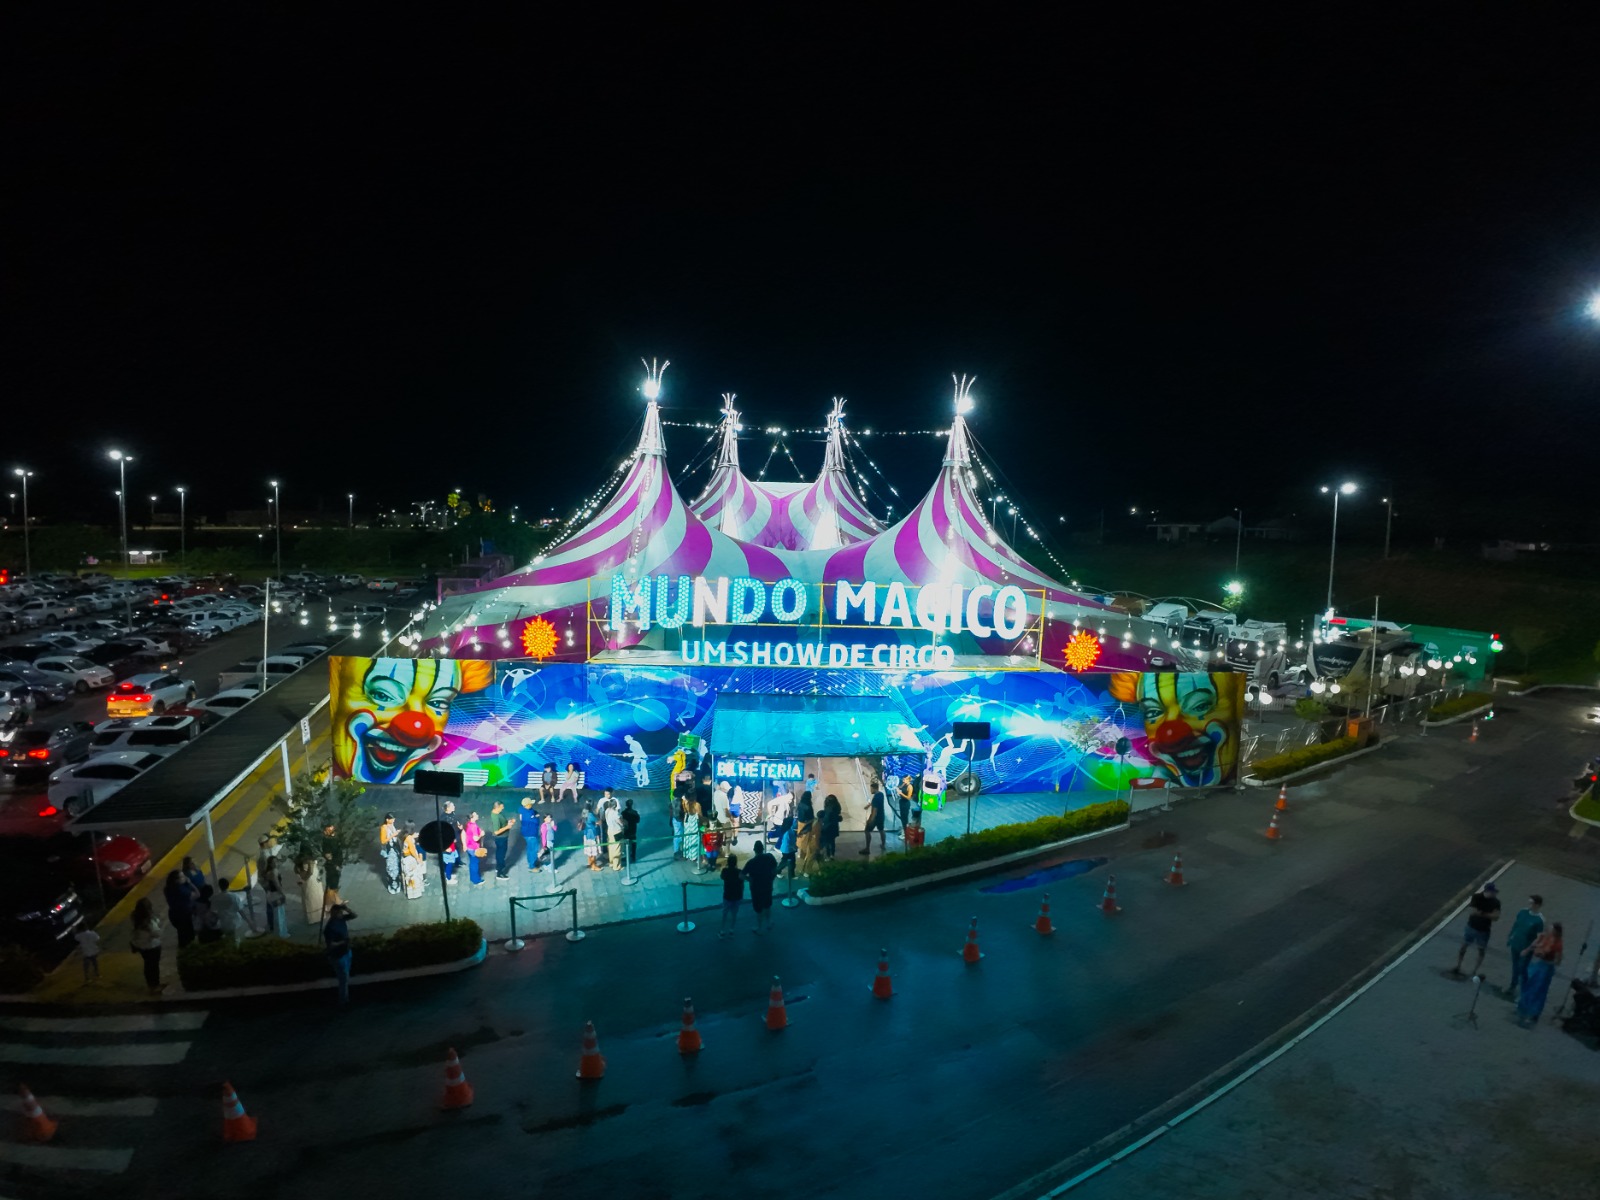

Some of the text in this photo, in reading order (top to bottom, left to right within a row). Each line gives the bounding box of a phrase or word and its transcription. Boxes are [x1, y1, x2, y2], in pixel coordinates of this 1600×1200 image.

[611, 573, 808, 631] MUNDO
[681, 640, 956, 669] UM SHOW DE CIRCO
